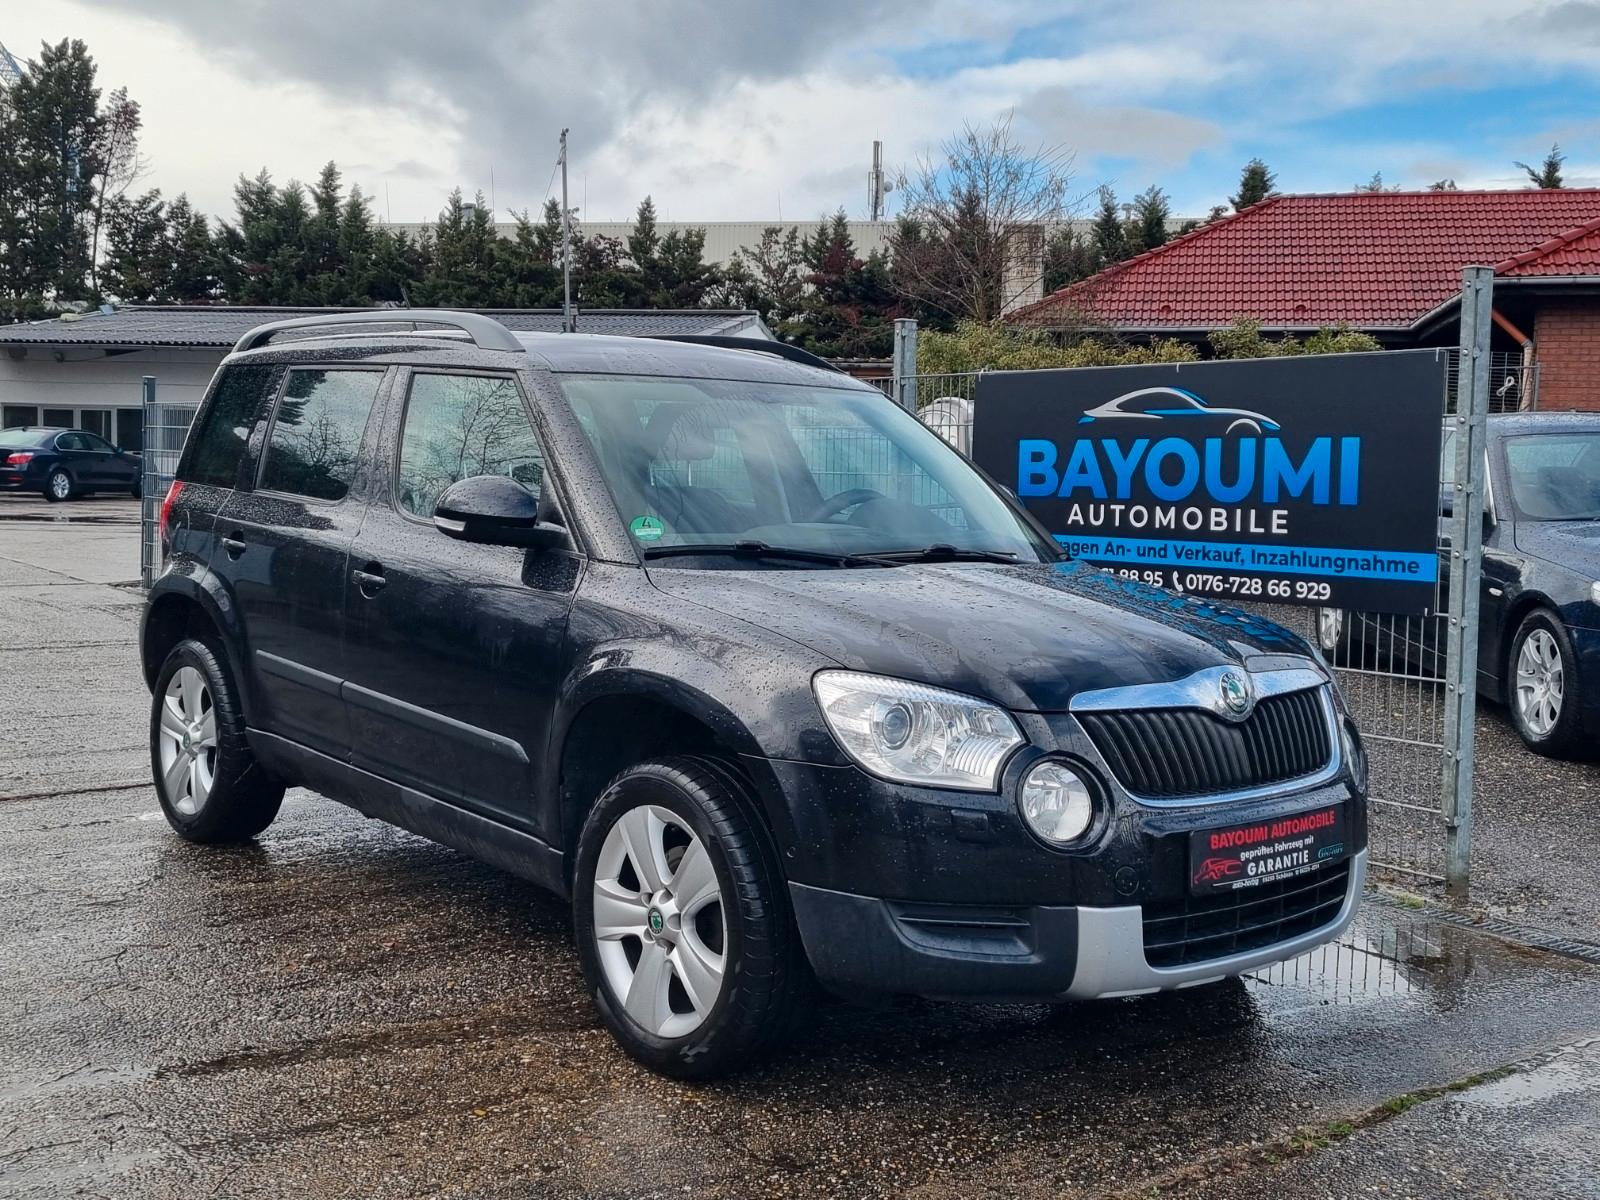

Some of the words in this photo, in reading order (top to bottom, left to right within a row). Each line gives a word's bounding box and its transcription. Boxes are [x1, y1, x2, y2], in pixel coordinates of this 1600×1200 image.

[1017, 436, 1361, 505] BAYOUMI
[642, 517, 651, 528] 4
[1066, 503, 1289, 534] AUTOMOBILE
[1060, 541, 1099, 557] agen
[1103, 541, 1131, 556] An-
[1136, 544, 1168, 559] und
[1173, 545, 1245, 566] Verkauf,
[1250, 551, 1420, 574] Inzahlungnahme
[1143, 570, 1163, 587] 95
[1185, 573, 1263, 595] 0176-728
[1267, 580, 1291, 597] 66
[1295, 581, 1331, 600] 929
[1210, 827, 1268, 849] BAYOUMI
[1271, 810, 1336, 838] AUTOMOBILE
[1239, 845, 1274, 861] geprüftes
[1274, 839, 1303, 852] Fahrzeug
[1304, 835, 1314, 845] mit
[1247, 850, 1309, 876] GARANTIE
